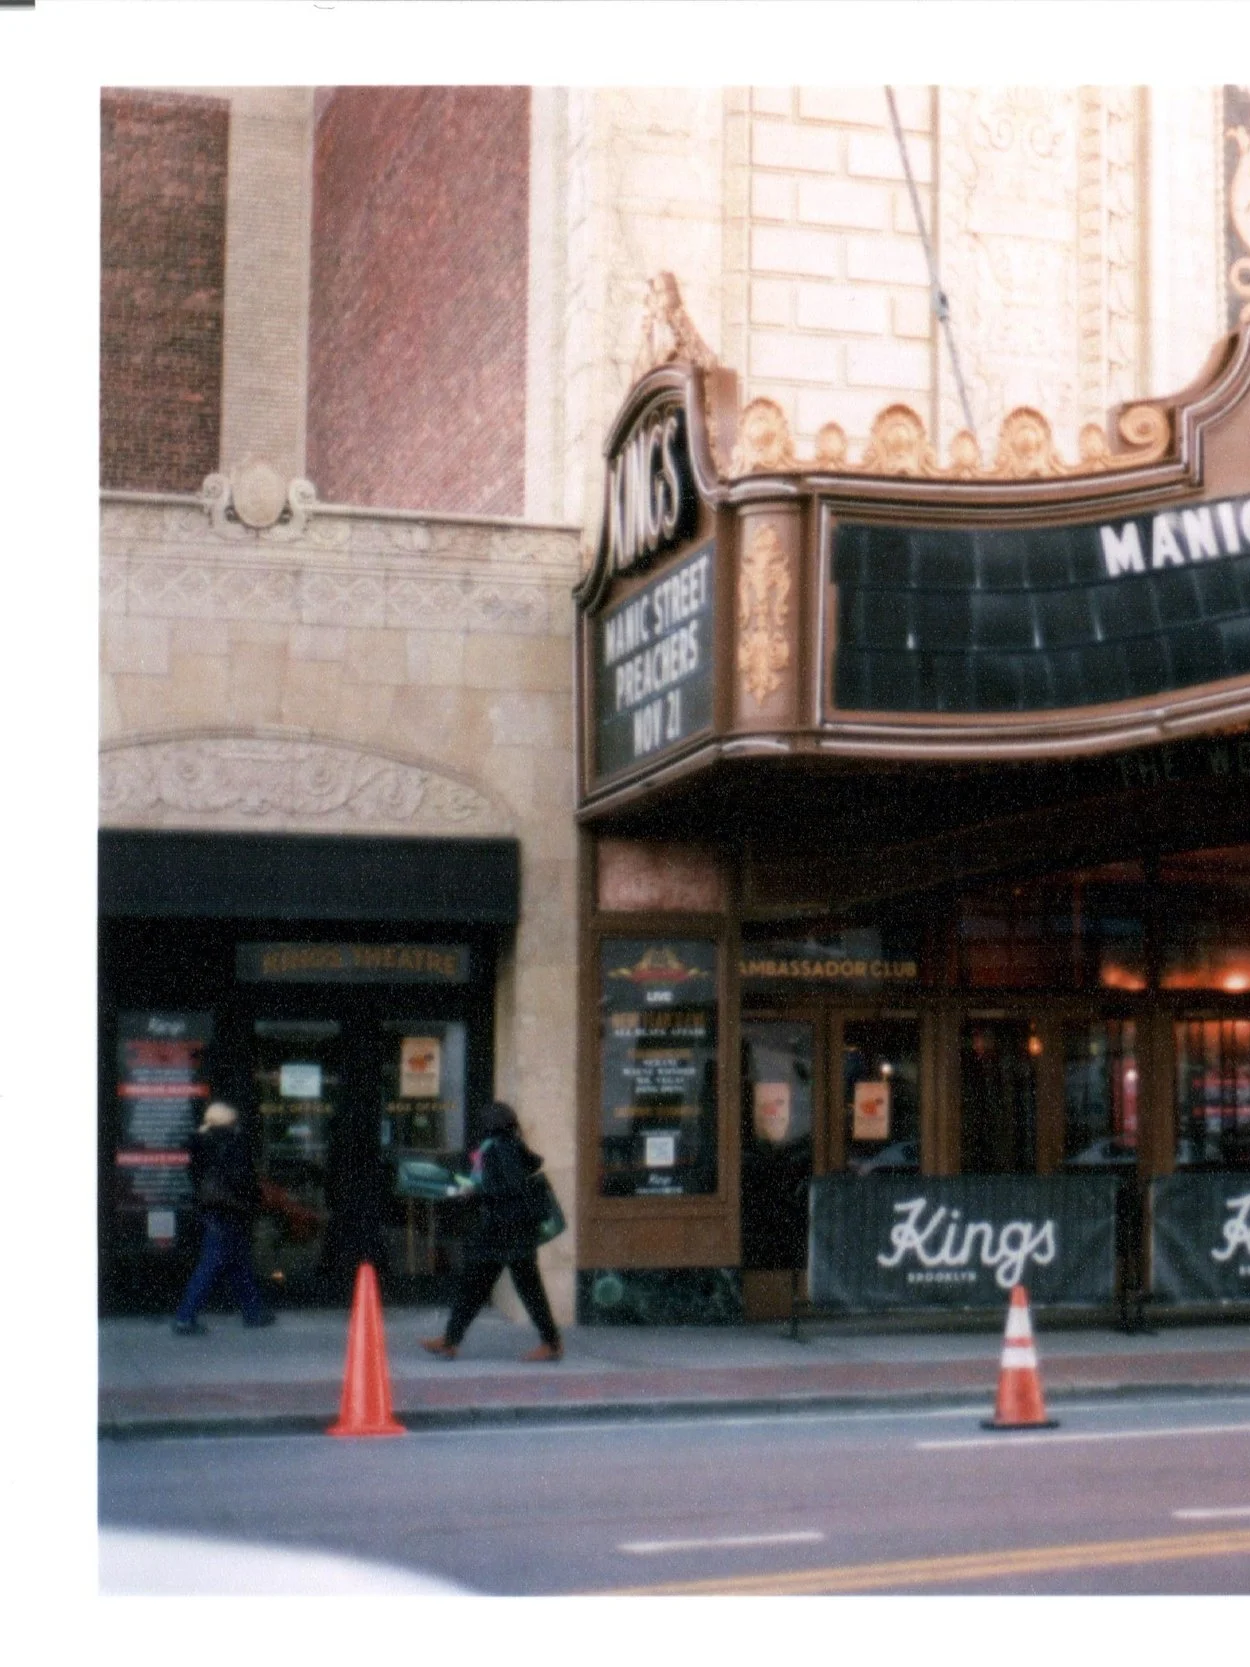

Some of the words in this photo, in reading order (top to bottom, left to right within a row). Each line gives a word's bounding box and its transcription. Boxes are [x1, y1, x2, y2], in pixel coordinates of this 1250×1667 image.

[610, 412, 682, 574] KINGS
[605, 595, 652, 667] MANIC
[652, 553, 710, 633] STREET
[616, 619, 700, 712] PREACHERS
[634, 698, 663, 758] NOV
[665, 688, 682, 740] 21
[877, 1197, 1056, 1288] Kings
[908, 1272, 976, 1282] BROOKLYN
